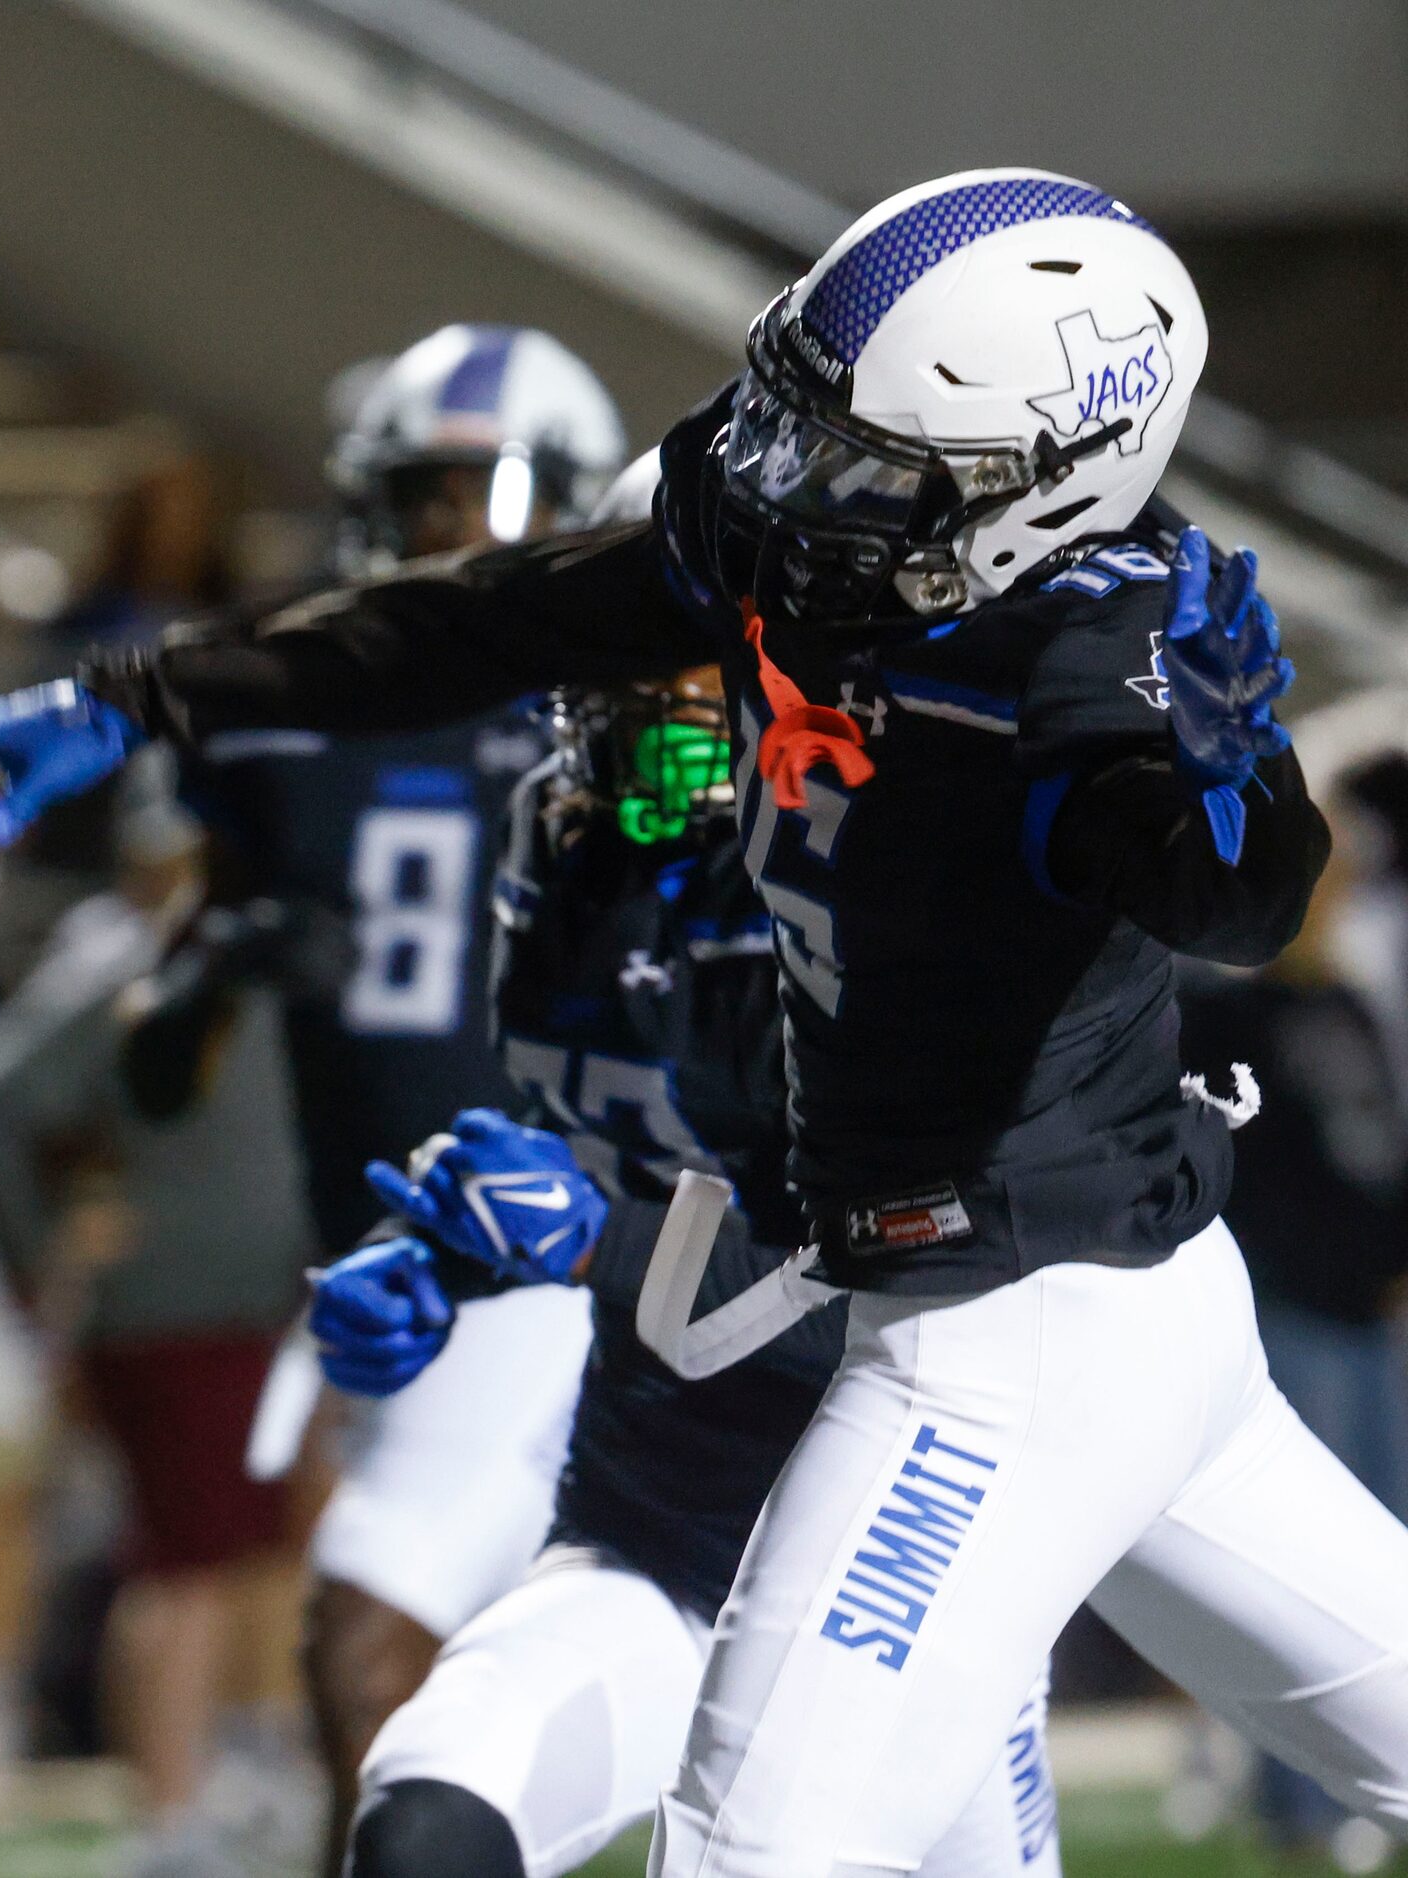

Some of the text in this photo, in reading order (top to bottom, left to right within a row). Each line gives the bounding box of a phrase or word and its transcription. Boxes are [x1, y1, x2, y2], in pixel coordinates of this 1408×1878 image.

[1079, 344, 1158, 421] JAGS
[342, 808, 475, 1035] 8
[820, 1424, 998, 1672] SUMMIT
